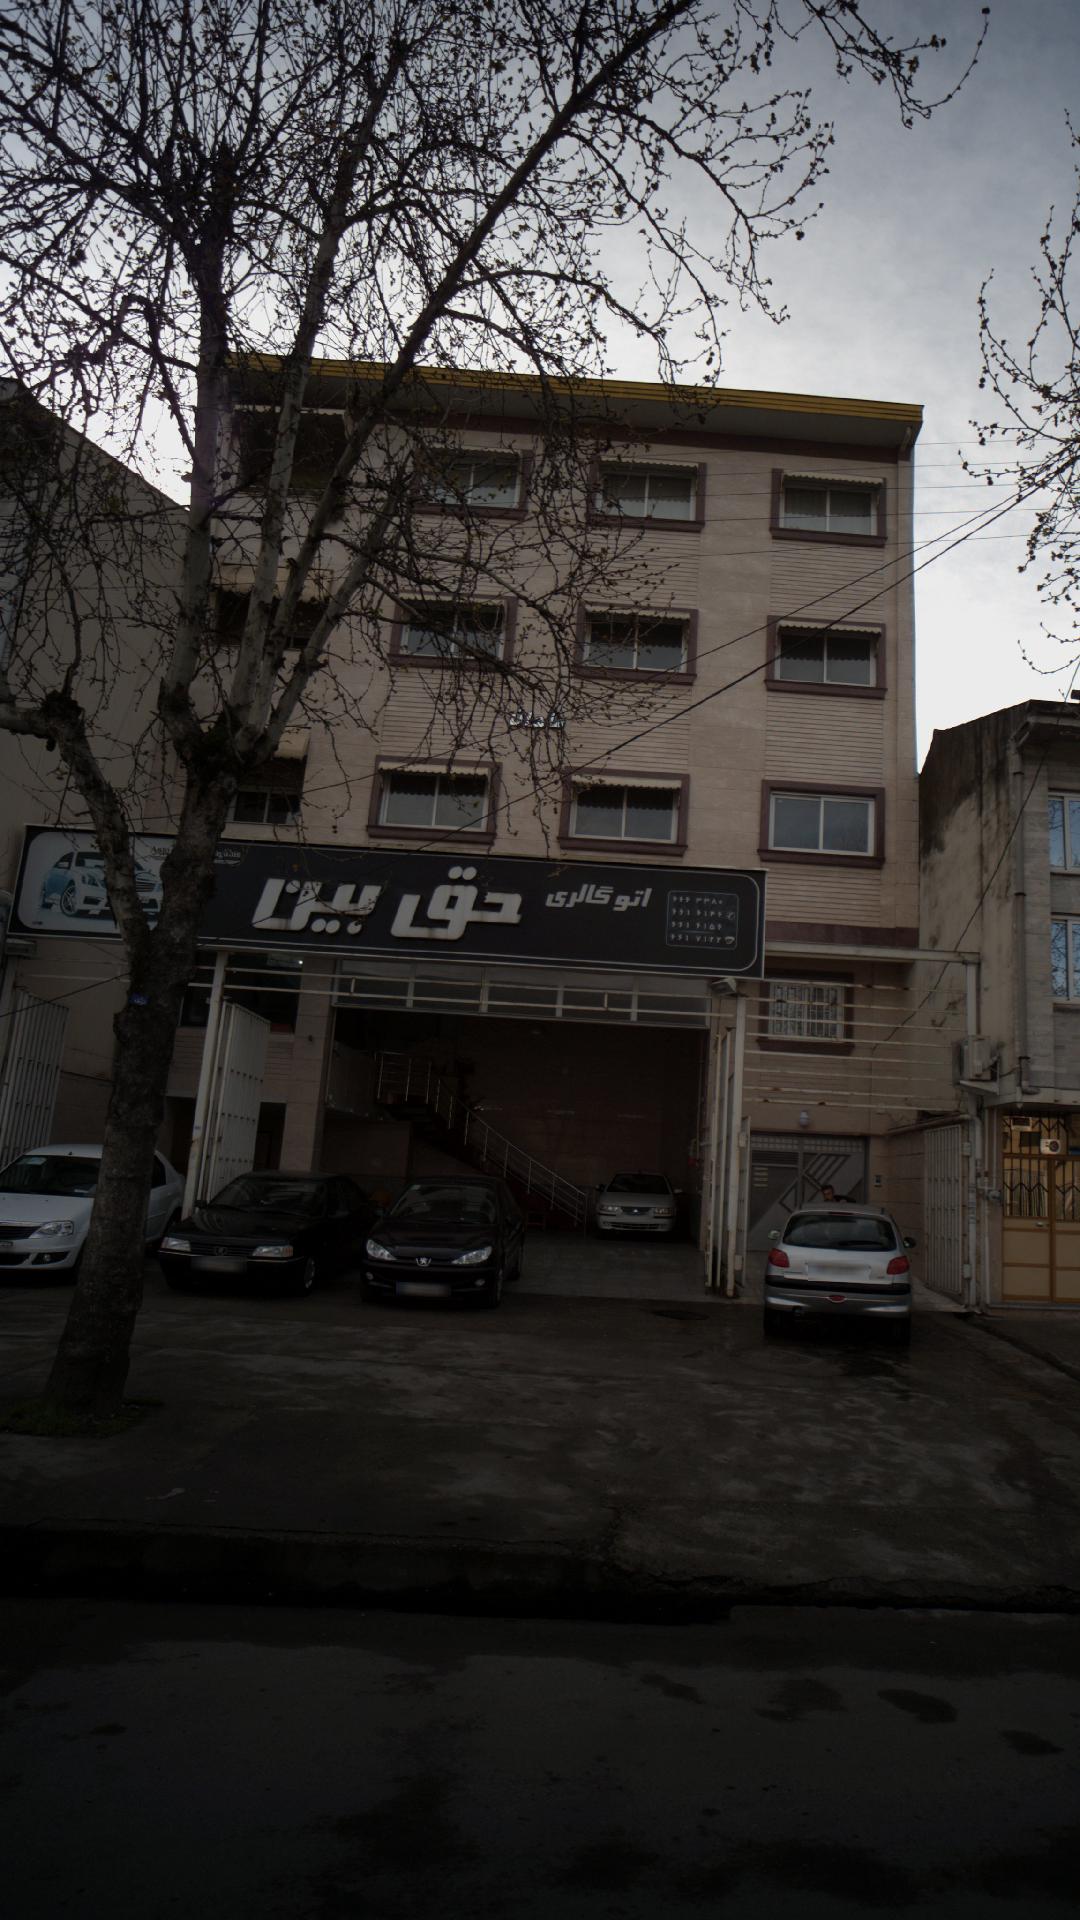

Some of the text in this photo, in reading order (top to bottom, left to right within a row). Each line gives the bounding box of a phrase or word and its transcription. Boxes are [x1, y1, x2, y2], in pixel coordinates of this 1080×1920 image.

[251, 866, 653, 941] اتو گالری حق بین
